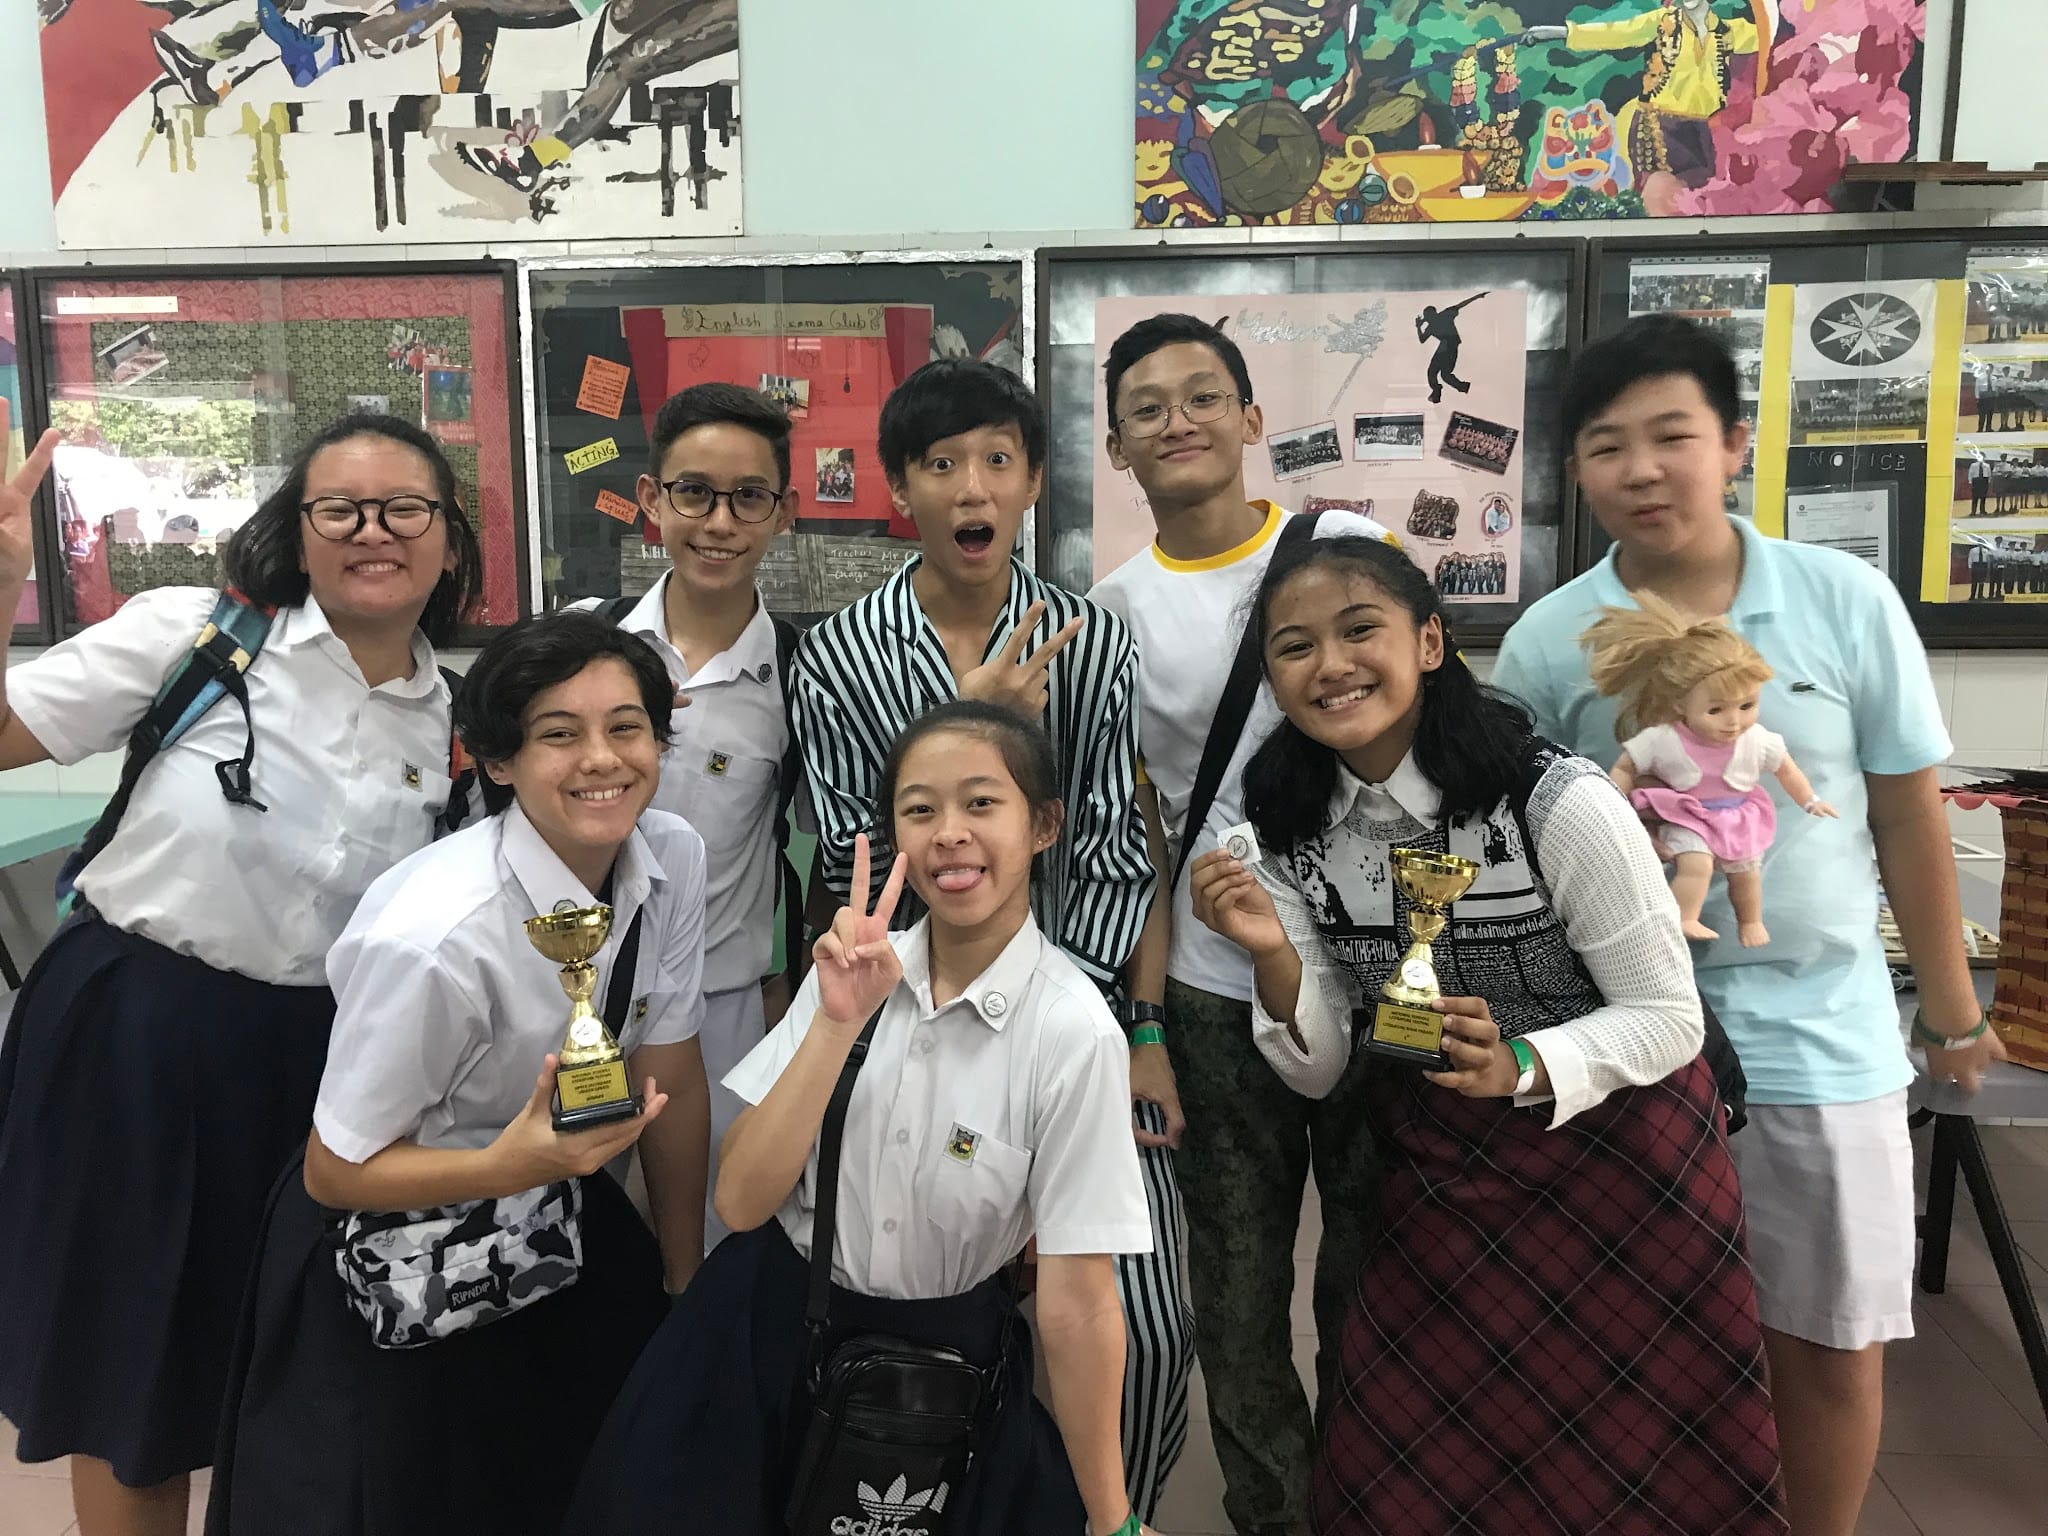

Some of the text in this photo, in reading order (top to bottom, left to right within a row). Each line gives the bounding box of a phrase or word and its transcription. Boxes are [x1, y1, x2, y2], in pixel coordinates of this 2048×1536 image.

[696, 309, 761, 332] English
[829, 309, 866, 330] Club
[568, 445, 615, 471] ACTING
[1808, 451, 1906, 471] NOTICE
